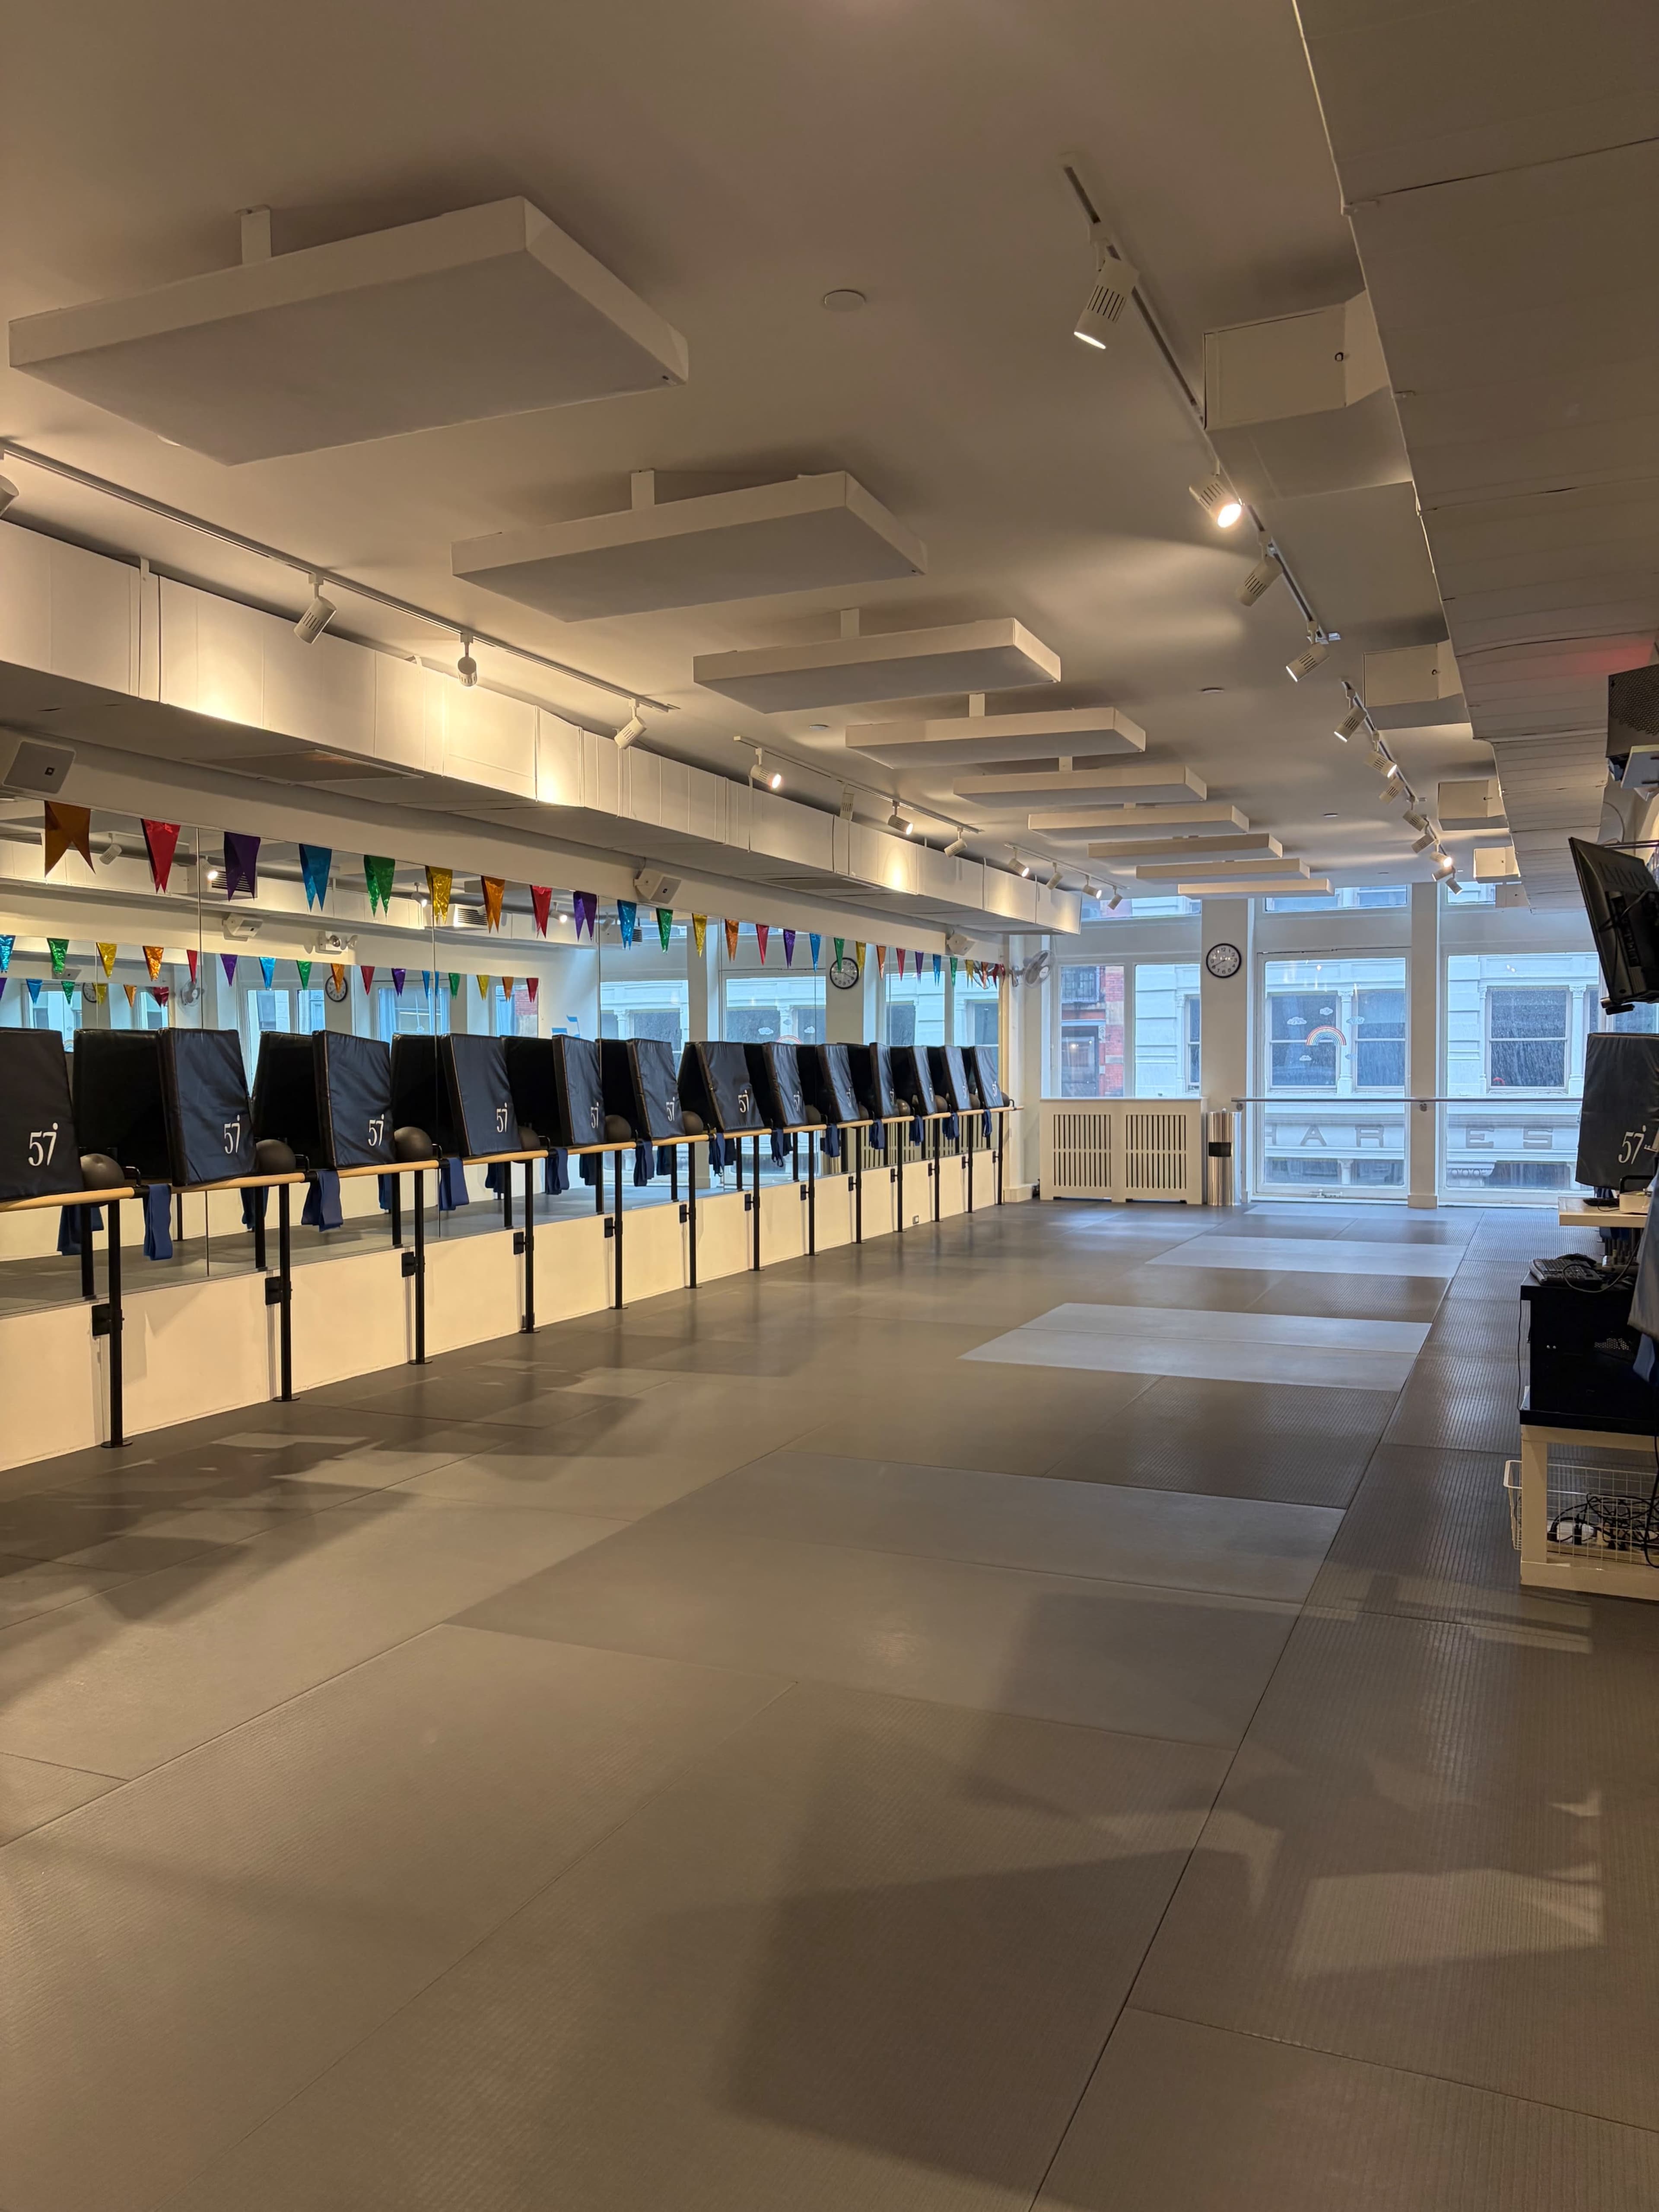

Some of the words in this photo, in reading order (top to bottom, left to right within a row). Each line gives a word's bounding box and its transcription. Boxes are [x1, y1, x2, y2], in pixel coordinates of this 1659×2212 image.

[591, 1102, 599, 1129] 57
[666, 1097, 675, 1121] 57
[738, 1089, 749, 1113] 57
[368, 1114, 385, 1146] 57
[496, 1102, 507, 1133] 57
[28, 1122, 58, 1166] 57
[223, 1114, 240, 1154] 57
[1618, 1125, 1646, 1165] 57
